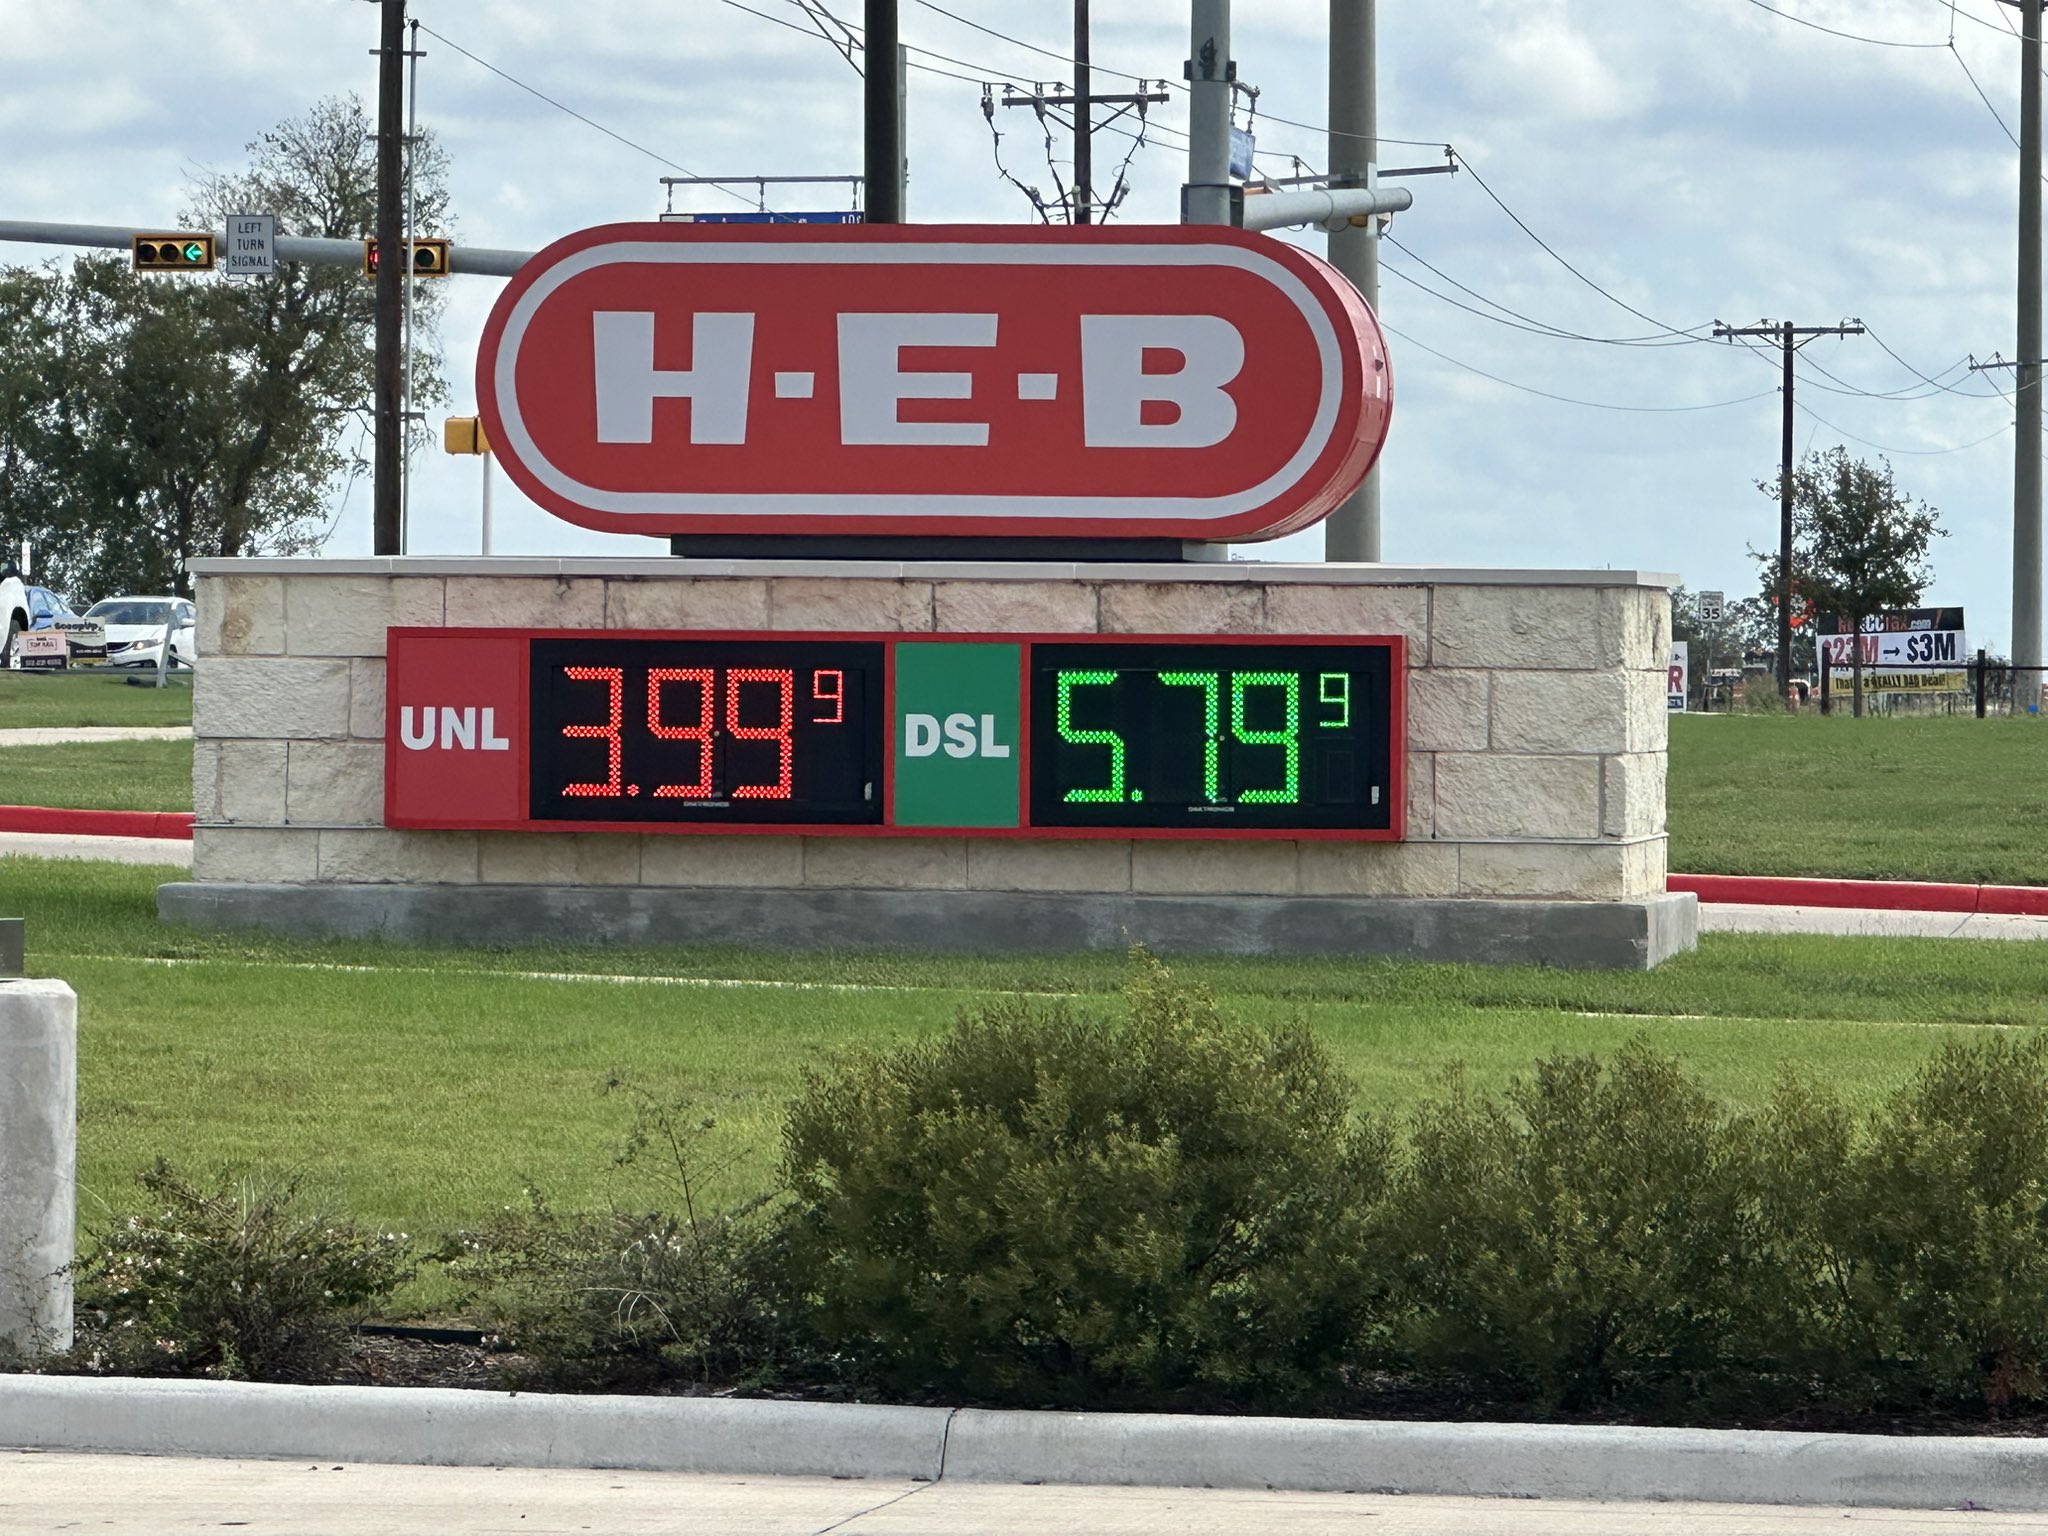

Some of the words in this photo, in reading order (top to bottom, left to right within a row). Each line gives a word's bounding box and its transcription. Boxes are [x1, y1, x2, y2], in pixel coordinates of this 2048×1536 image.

[237, 238, 265, 250] TURN
[238, 222, 262, 233] LEFT
[231, 255, 270, 267] SIGNAL
[593, 311, 1245, 448] H-E-B
[1702, 607, 1720, 620] 35
[1907, 632, 1956, 663] $3M
[400, 706, 510, 751] UNL
[561, 667, 793, 799] 3.99
[812, 670, 844, 723] 9
[904, 712, 1010, 758] DSL
[1057, 671, 1299, 803] 5.79
[1318, 672, 1350, 728] 9
